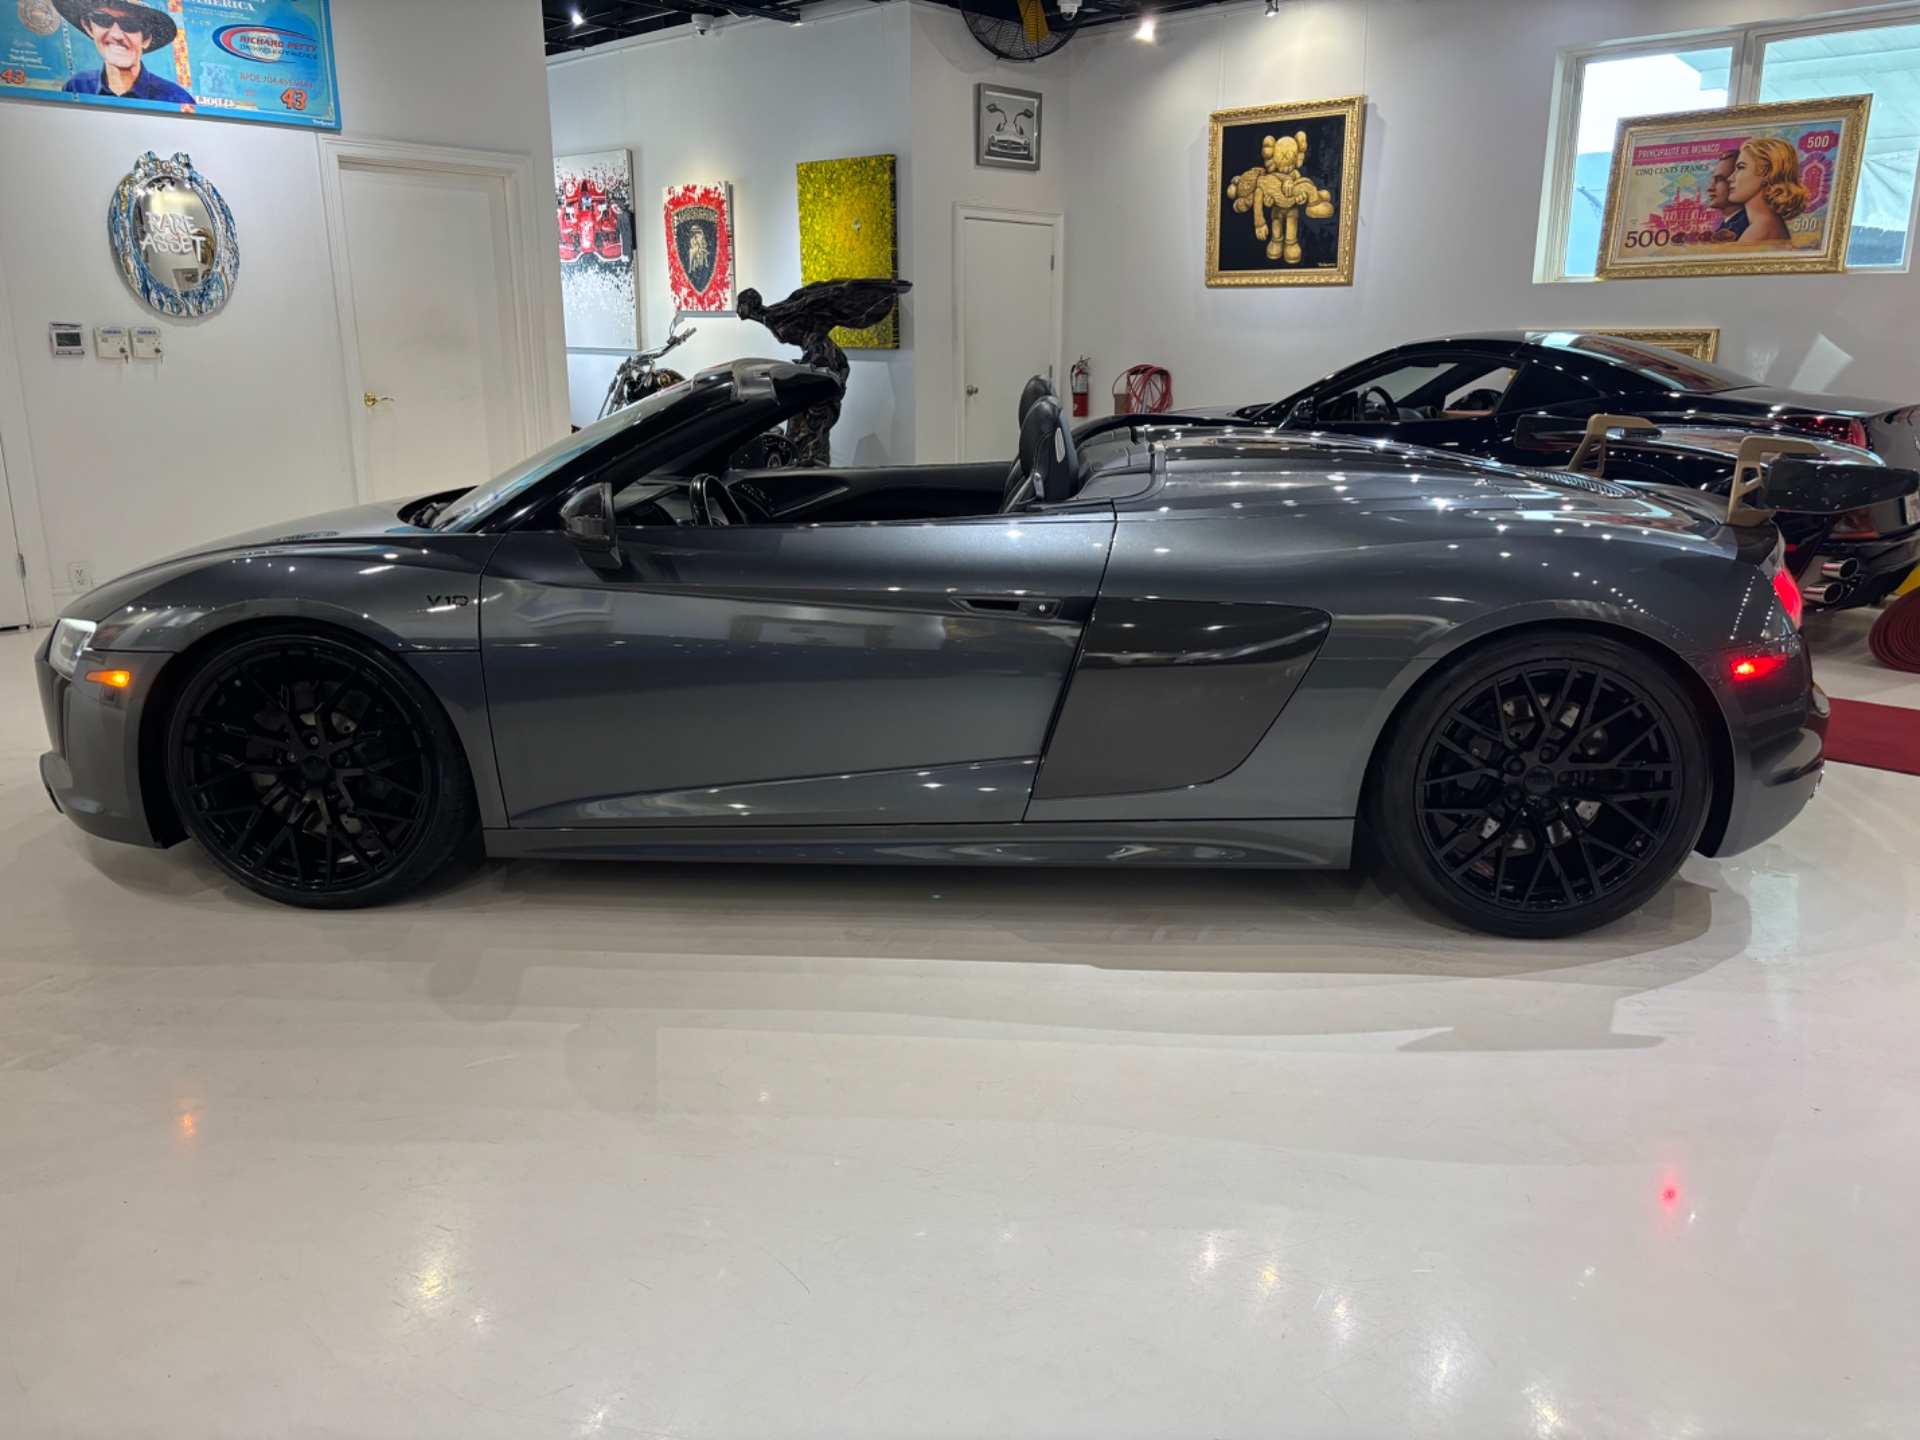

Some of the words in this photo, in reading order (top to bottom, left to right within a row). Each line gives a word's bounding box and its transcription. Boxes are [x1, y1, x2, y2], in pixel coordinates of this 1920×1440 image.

[239, 35, 285, 48] RICHARD
[287, 41, 318, 53] PETTY
[0, 68, 26, 85] 43
[280, 88, 308, 111] 43
[1681, 145, 1691, 155] DE
[1691, 143, 1720, 155] MONACO
[1807, 135, 1830, 149] 500
[1635, 167, 1654, 177] CINQ
[1654, 166, 1679, 175] CENTS
[1680, 164, 1710, 174] FRANCS
[145, 211, 198, 234] RARE
[1792, 217, 1818, 232] 500
[139, 232, 207, 262] ASSET
[1624, 229, 1671, 249] 500
[426, 594, 469, 607] V10
